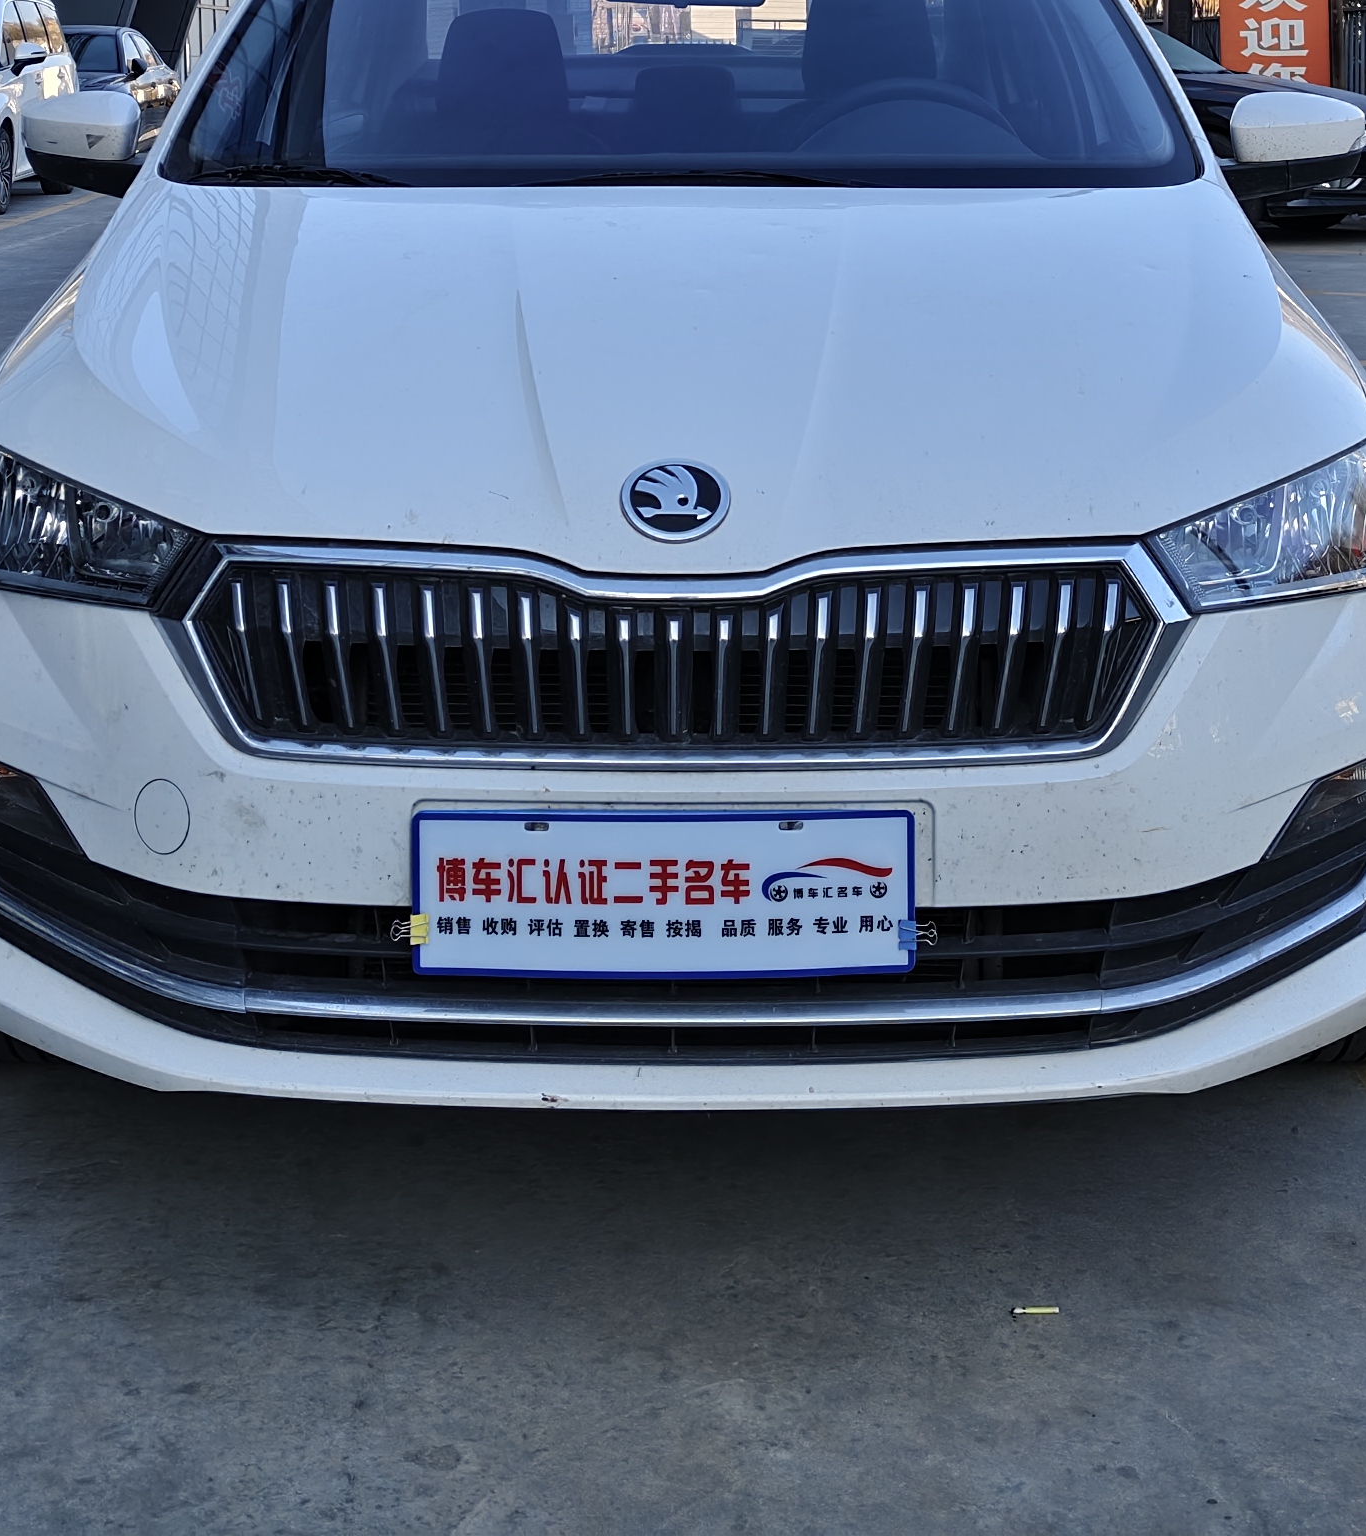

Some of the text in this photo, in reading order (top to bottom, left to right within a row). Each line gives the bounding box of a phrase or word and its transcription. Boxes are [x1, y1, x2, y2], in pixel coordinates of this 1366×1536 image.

[436, 857, 751, 905] 博车汇认证二手名车
[792, 885, 864, 900] 博车汇名车
[436, 914, 894, 939] 销售 收购 评估 置换 寄售 按揭 品质 服务 专业 用心
